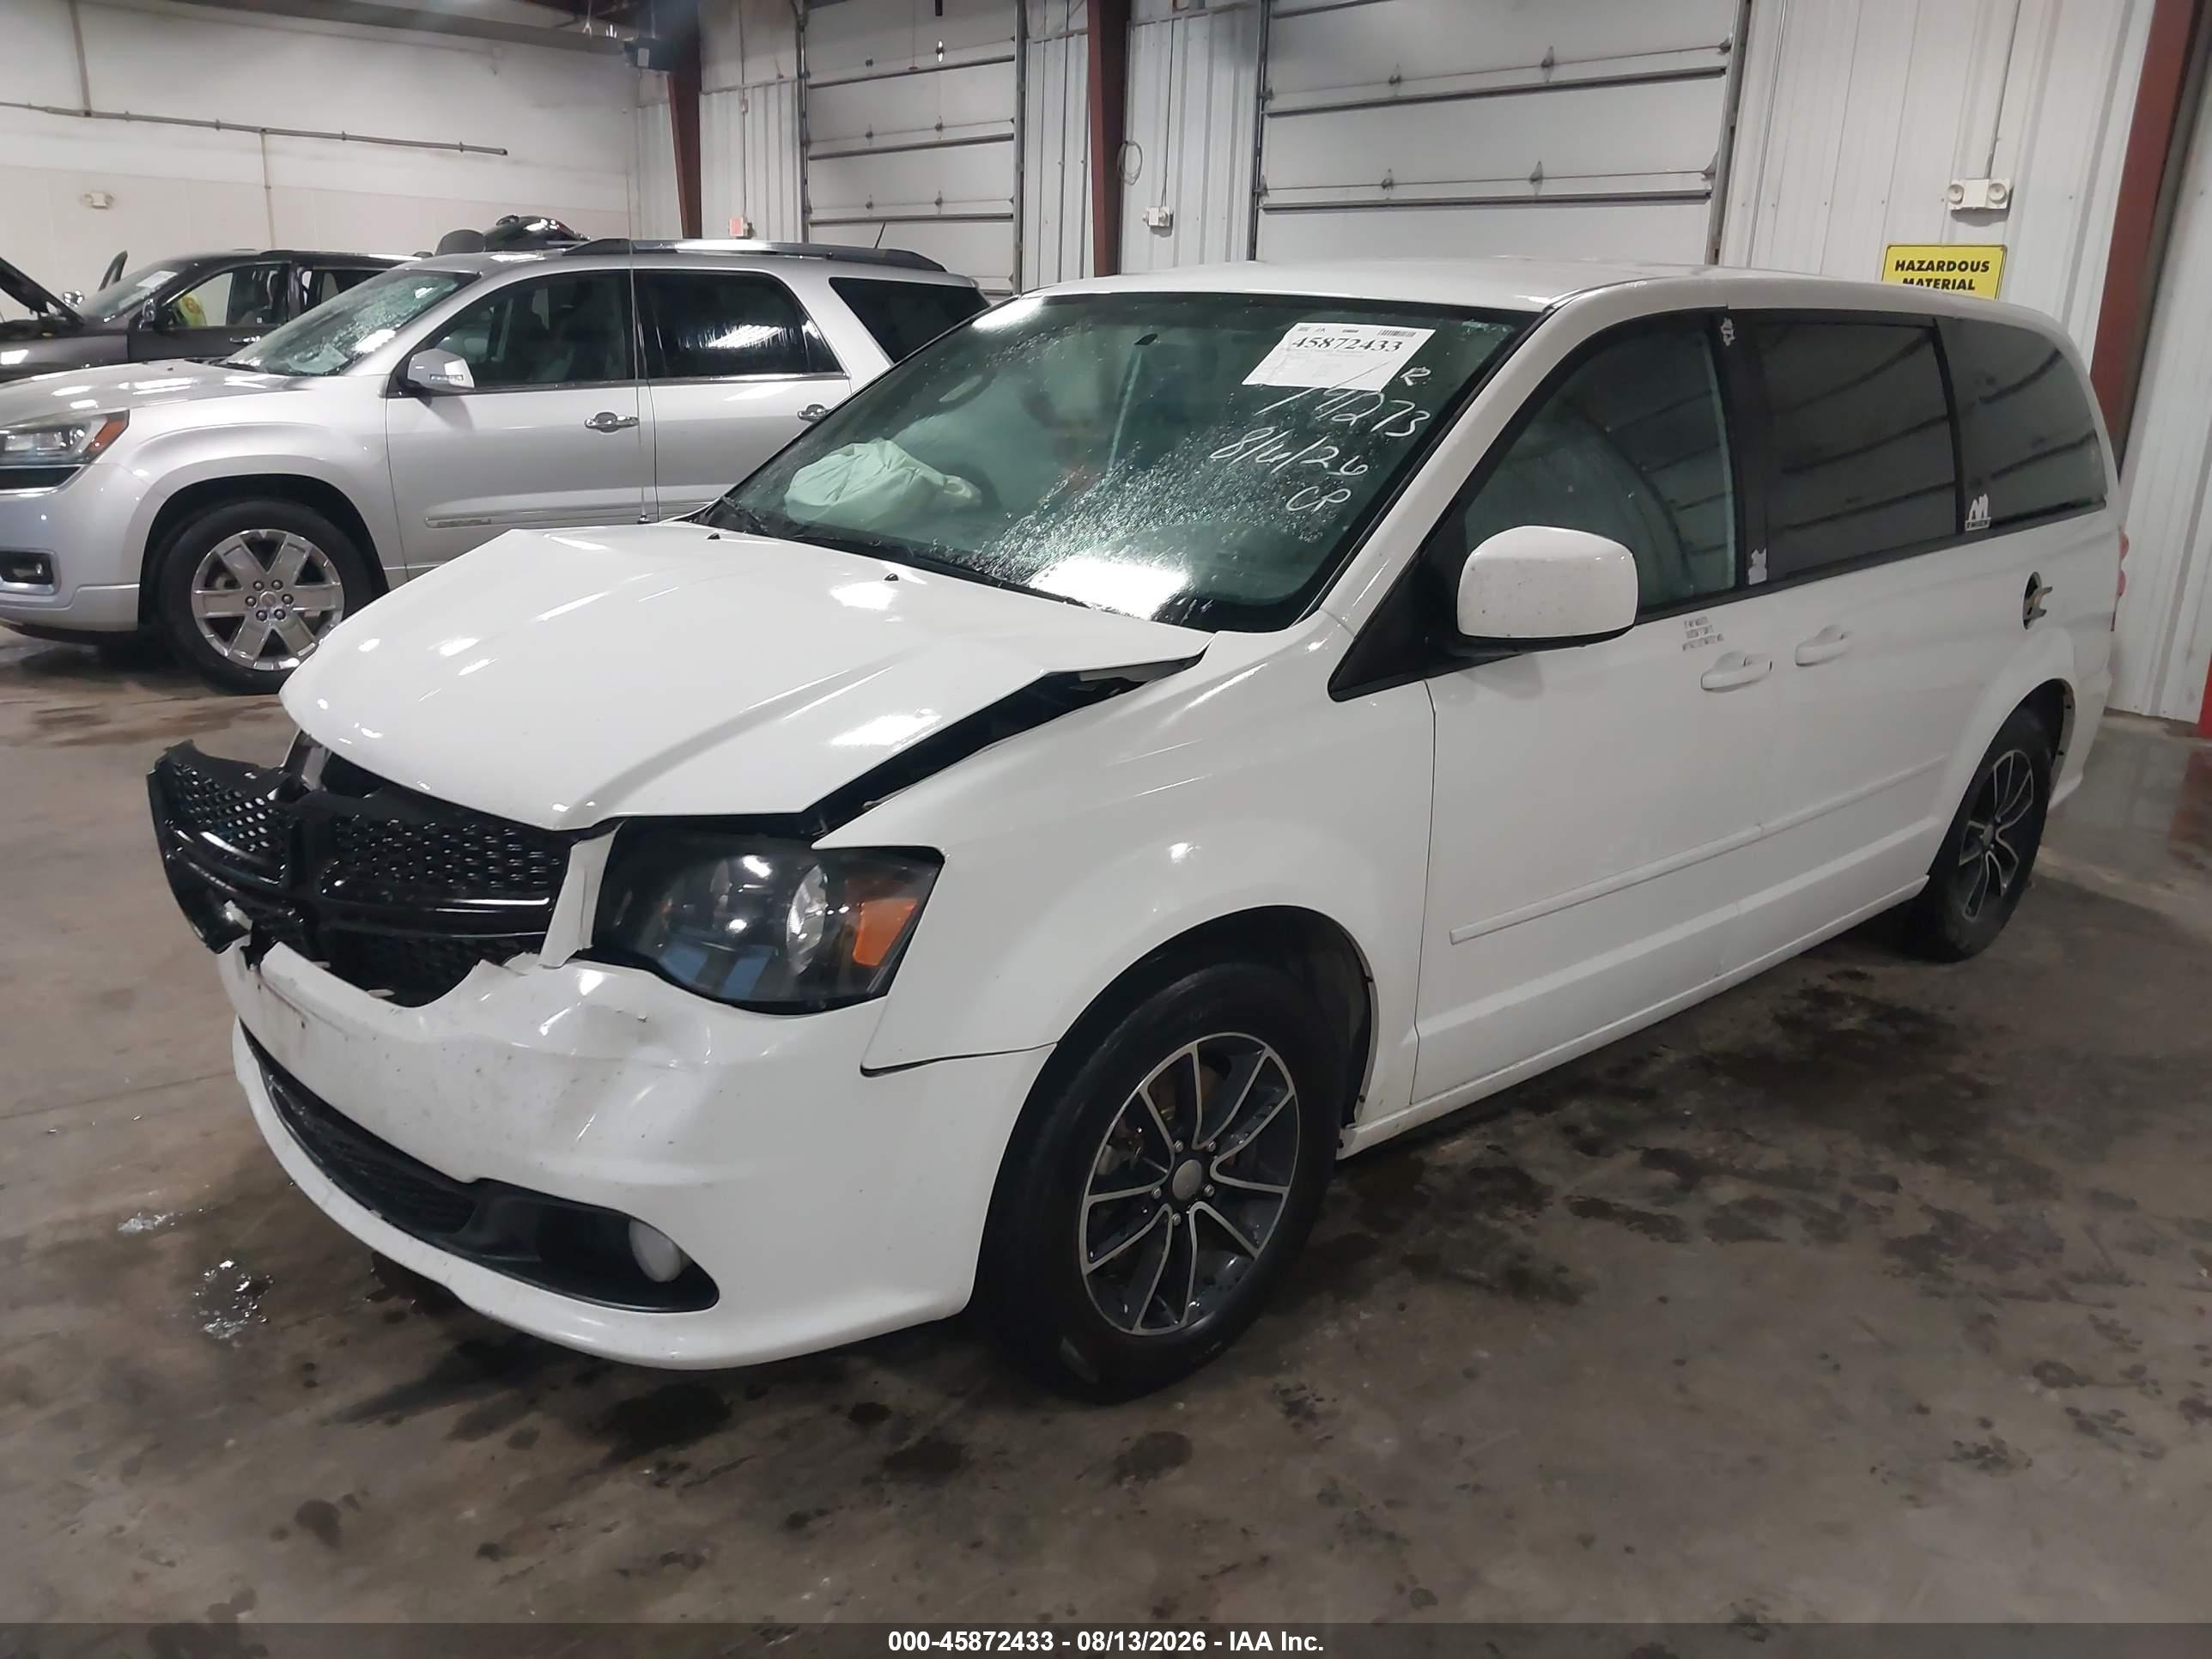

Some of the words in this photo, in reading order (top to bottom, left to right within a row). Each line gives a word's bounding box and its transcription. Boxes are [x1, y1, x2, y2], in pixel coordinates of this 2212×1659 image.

[1894, 259, 1990, 273] HAZARDOUS
[1902, 277, 1976, 290] MATERIAL
[1291, 336, 1404, 353] 45872433
